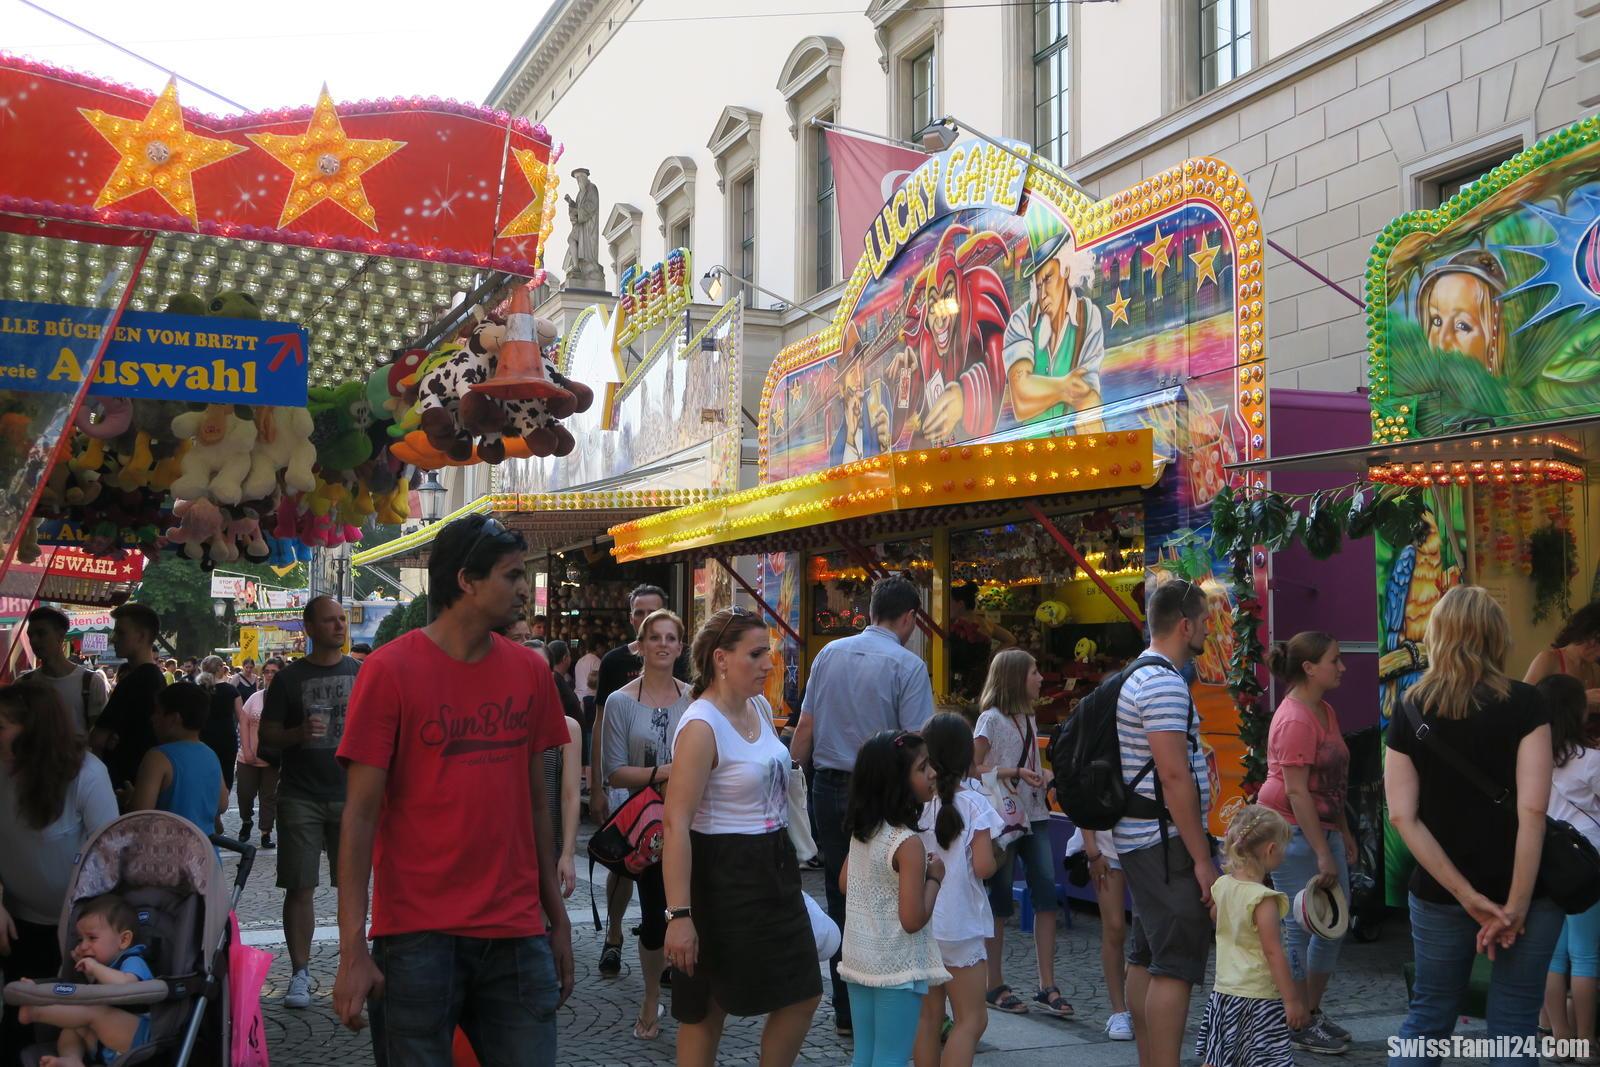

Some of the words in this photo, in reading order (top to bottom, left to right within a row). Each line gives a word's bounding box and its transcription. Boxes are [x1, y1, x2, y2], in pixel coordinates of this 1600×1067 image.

[865, 157, 940, 280] LUCKY
[944, 142, 1031, 211] GAME
[0, 317, 39, 335] LLE
[147, 329, 190, 347] VOM
[195, 332, 258, 351] BRETT
[0, 364, 37, 379] reie
[47, 347, 258, 393] Auswahl
[69, 615, 110, 627] sten.ch
